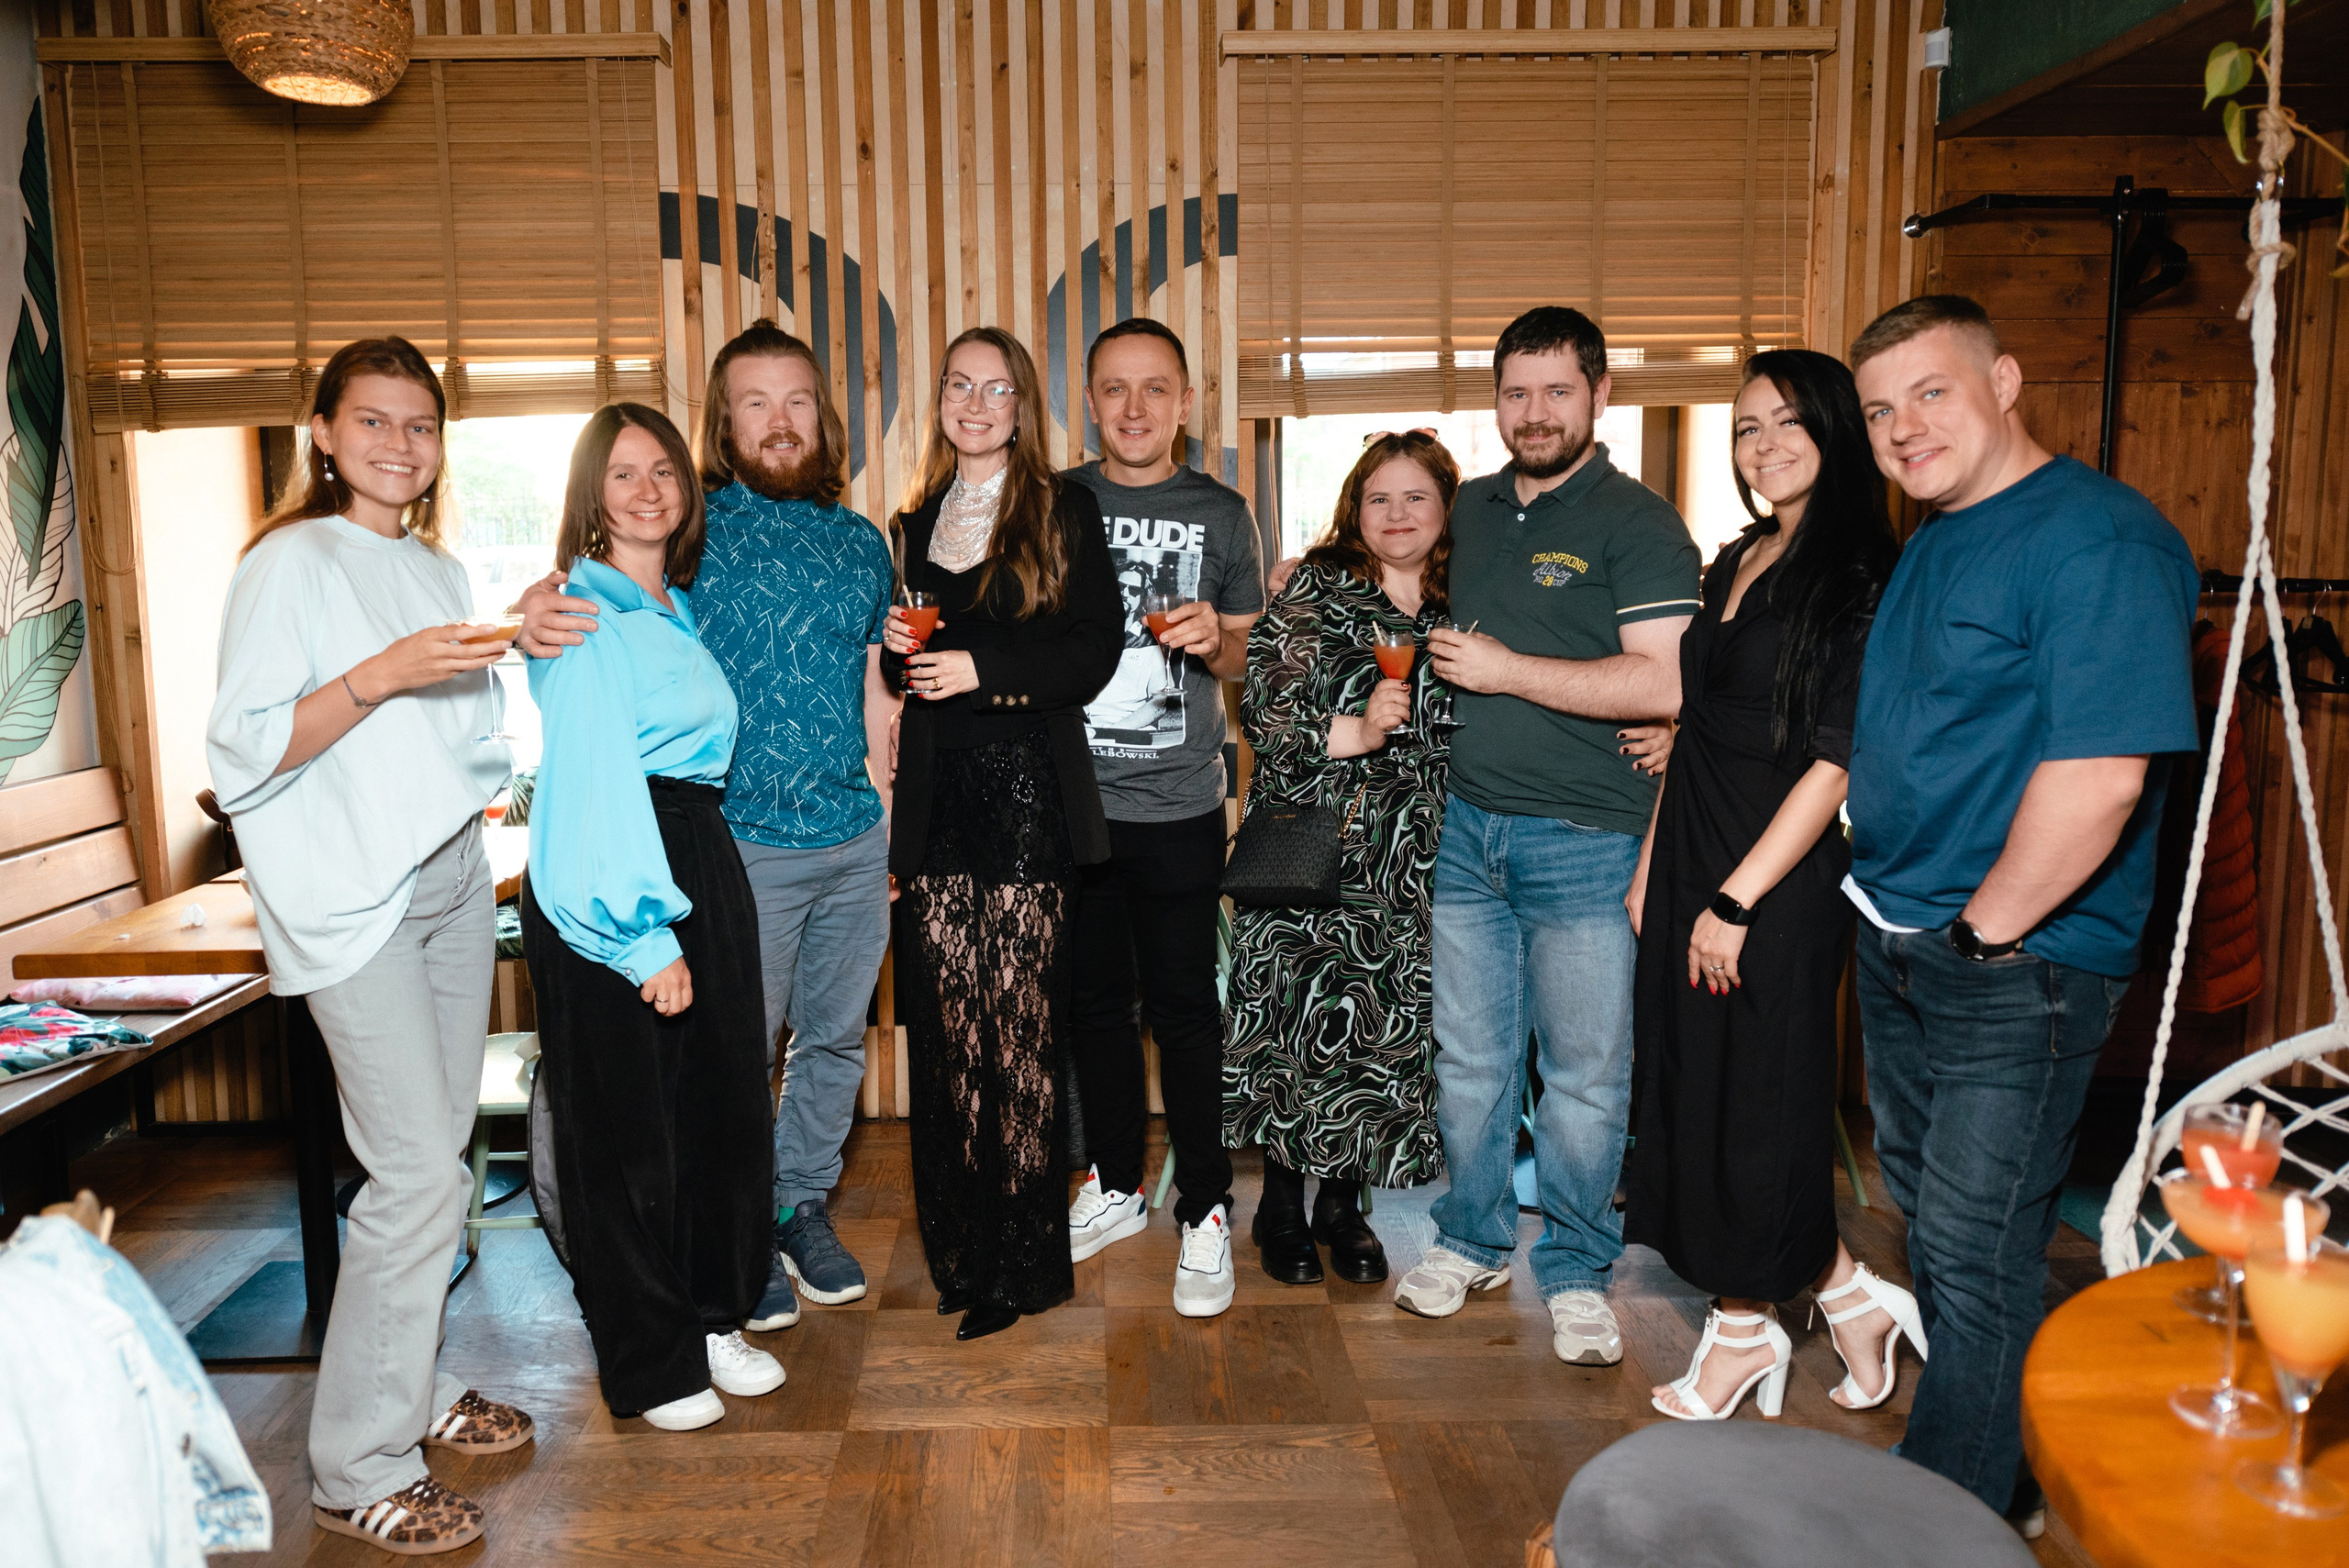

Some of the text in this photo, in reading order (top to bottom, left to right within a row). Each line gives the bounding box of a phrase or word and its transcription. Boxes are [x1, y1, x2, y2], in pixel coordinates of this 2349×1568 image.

[1112, 517, 1206, 552] DUDE
[1531, 552, 1588, 573] CHAMPIONS
[1532, 562, 1573, 581] Albion
